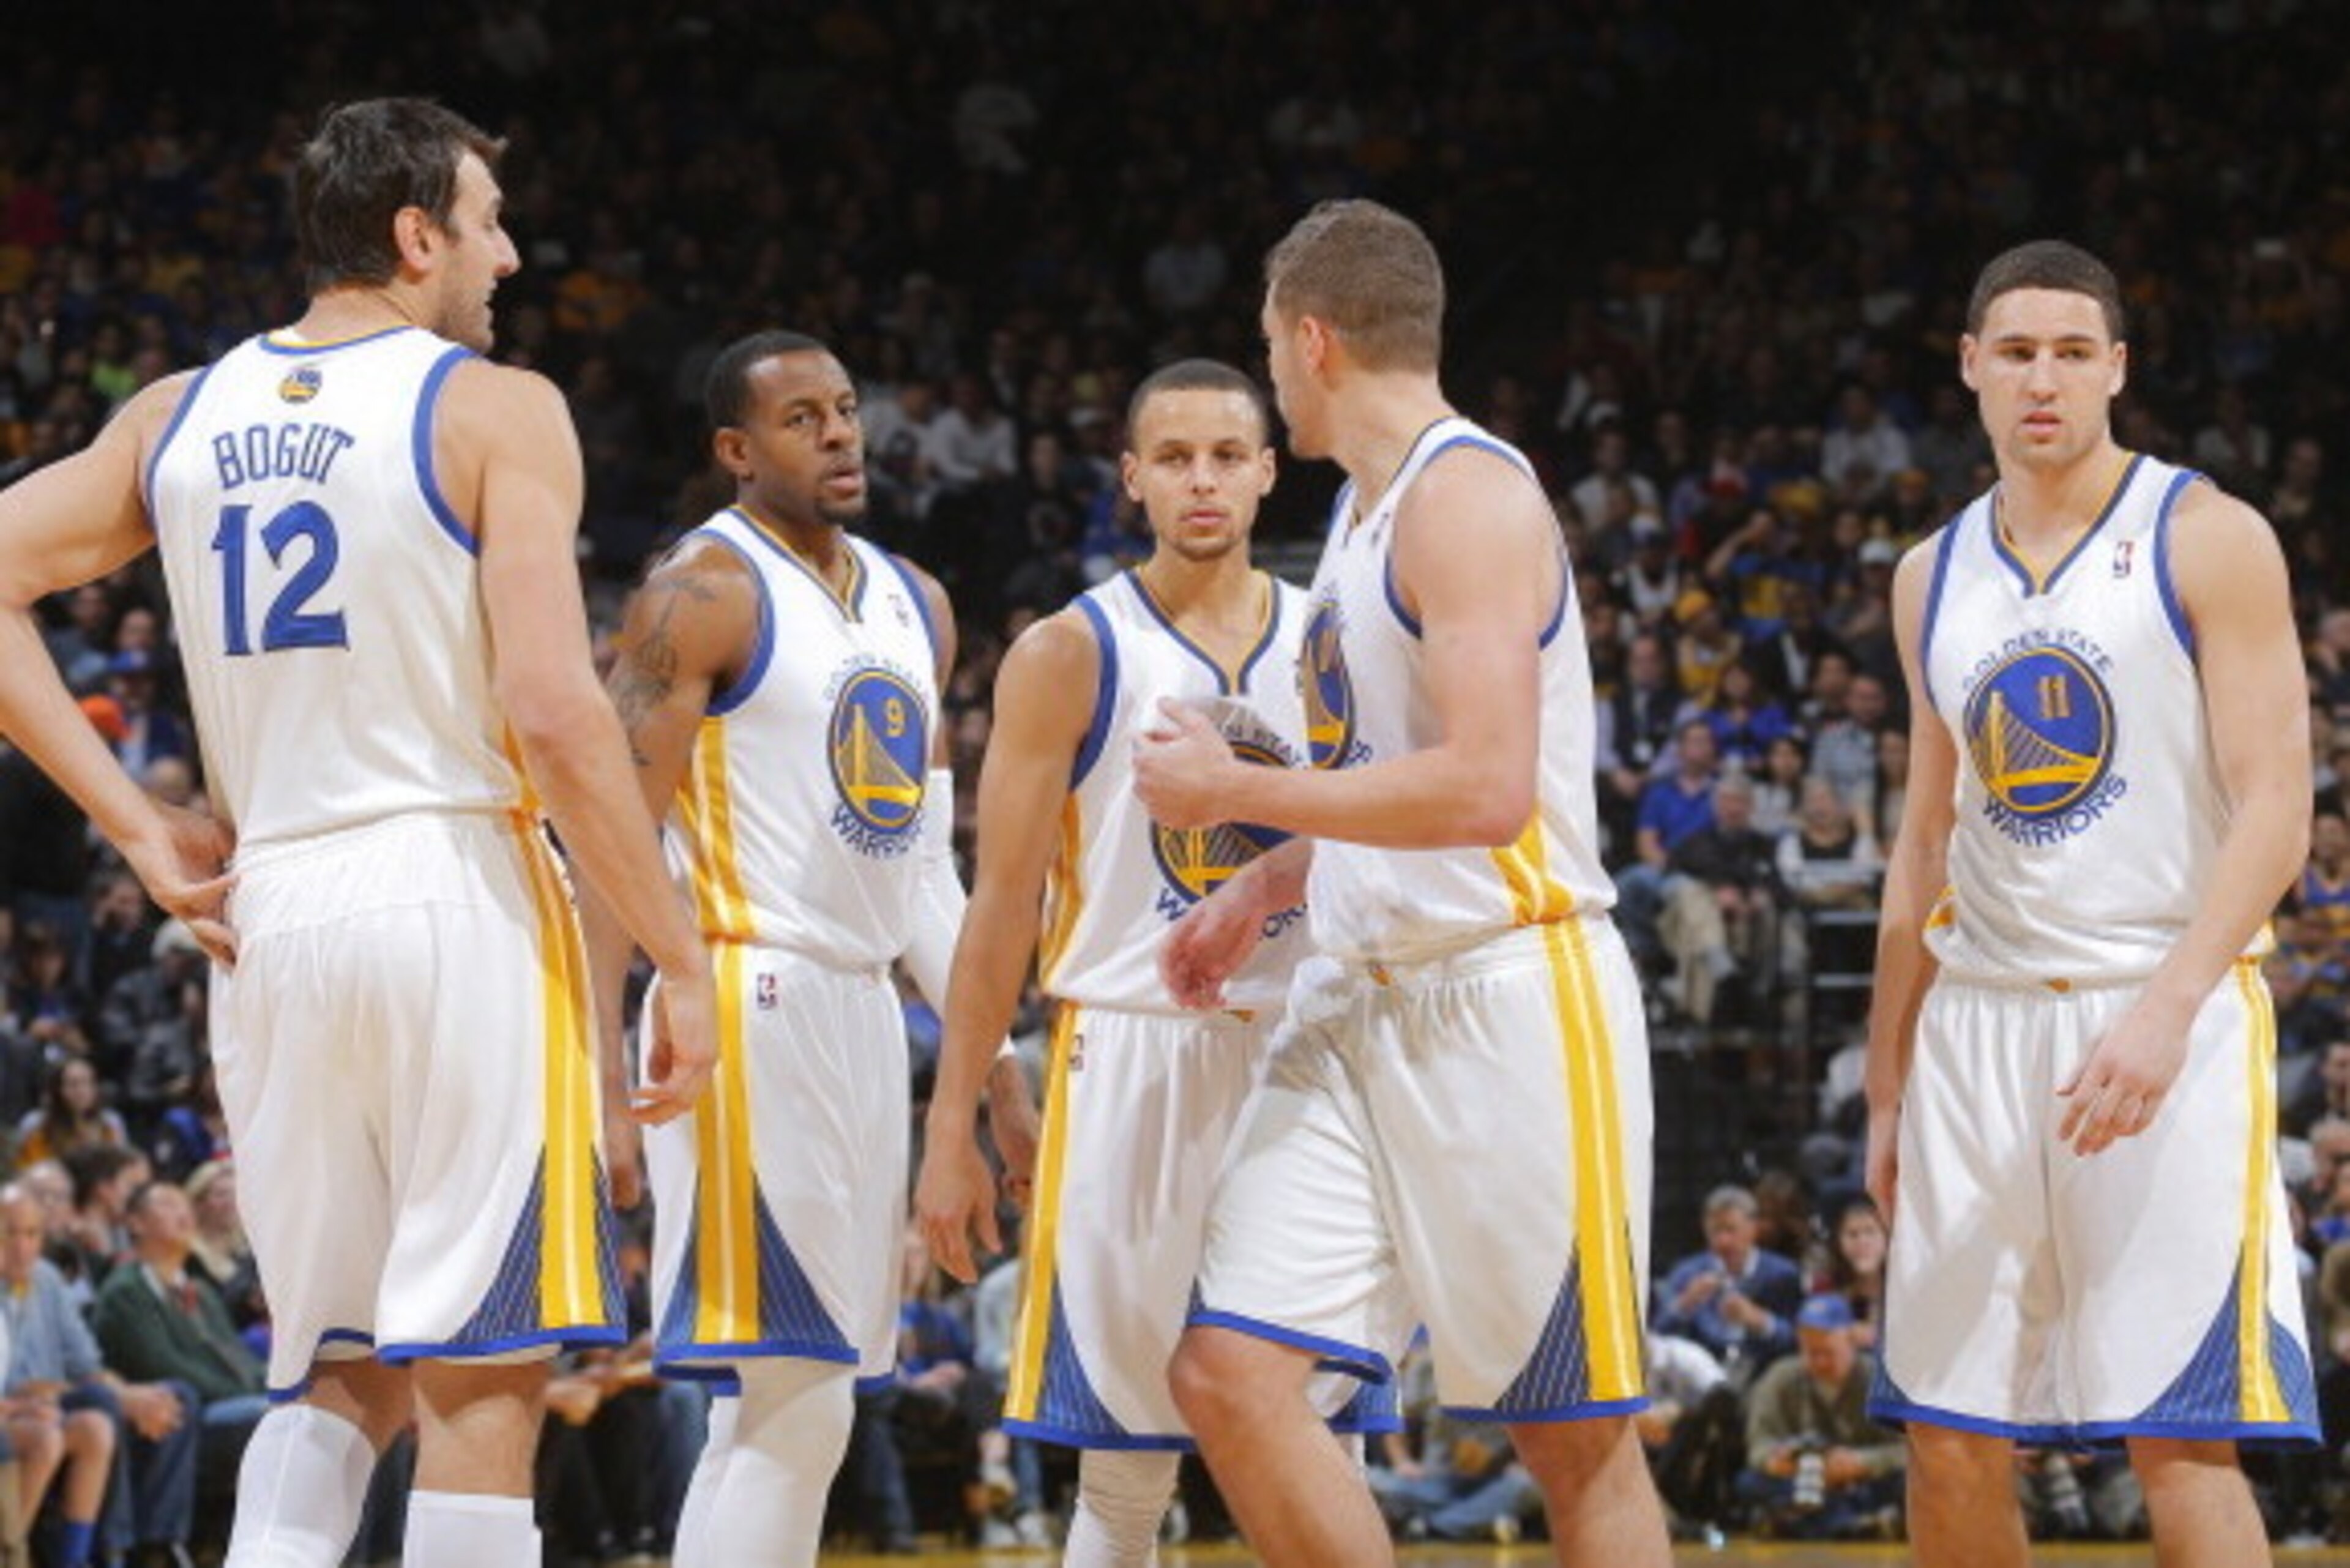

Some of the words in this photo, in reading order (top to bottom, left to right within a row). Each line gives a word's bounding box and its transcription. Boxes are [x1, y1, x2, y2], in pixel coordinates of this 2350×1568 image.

[212, 424, 355, 490] BOGUT
[211, 500, 351, 655] 12
[884, 696, 906, 738] 9
[2036, 673, 2073, 720] 11
[1982, 773, 2128, 847] WARRIORS
